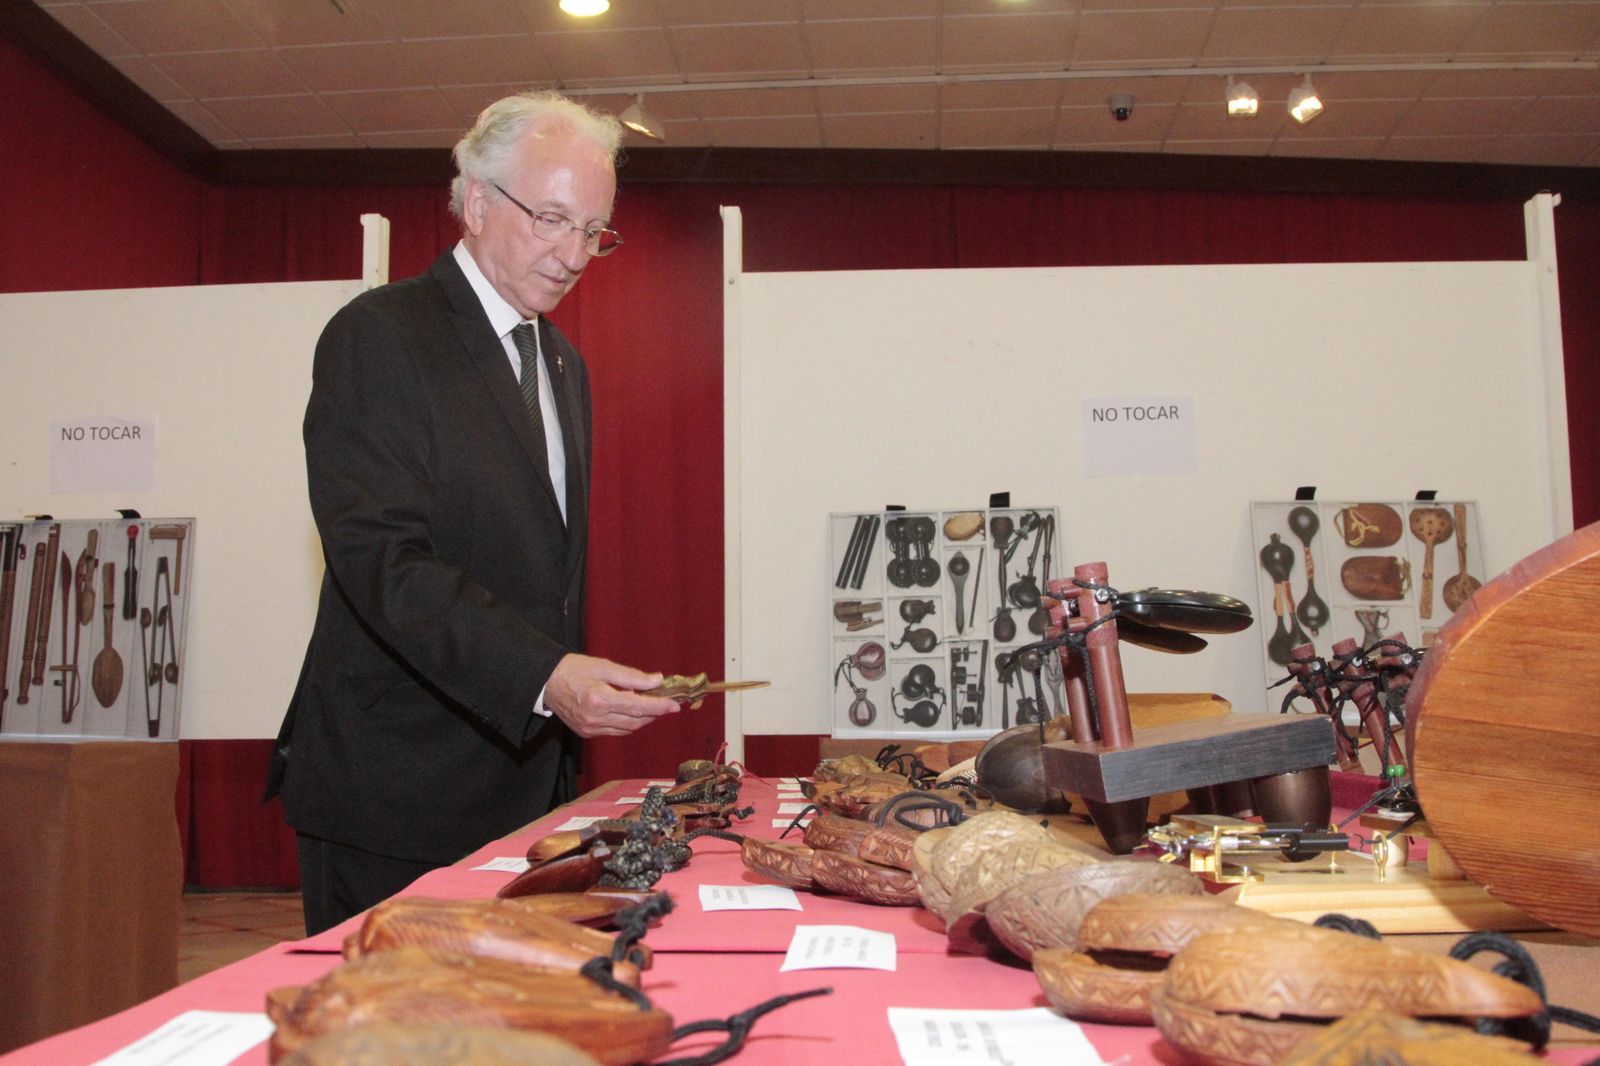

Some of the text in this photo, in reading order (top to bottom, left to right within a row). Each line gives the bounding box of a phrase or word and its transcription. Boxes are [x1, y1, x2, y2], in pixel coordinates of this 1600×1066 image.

[1092, 405, 1180, 422] NO TOCAR
[61, 426, 142, 441] NO TOCAR
